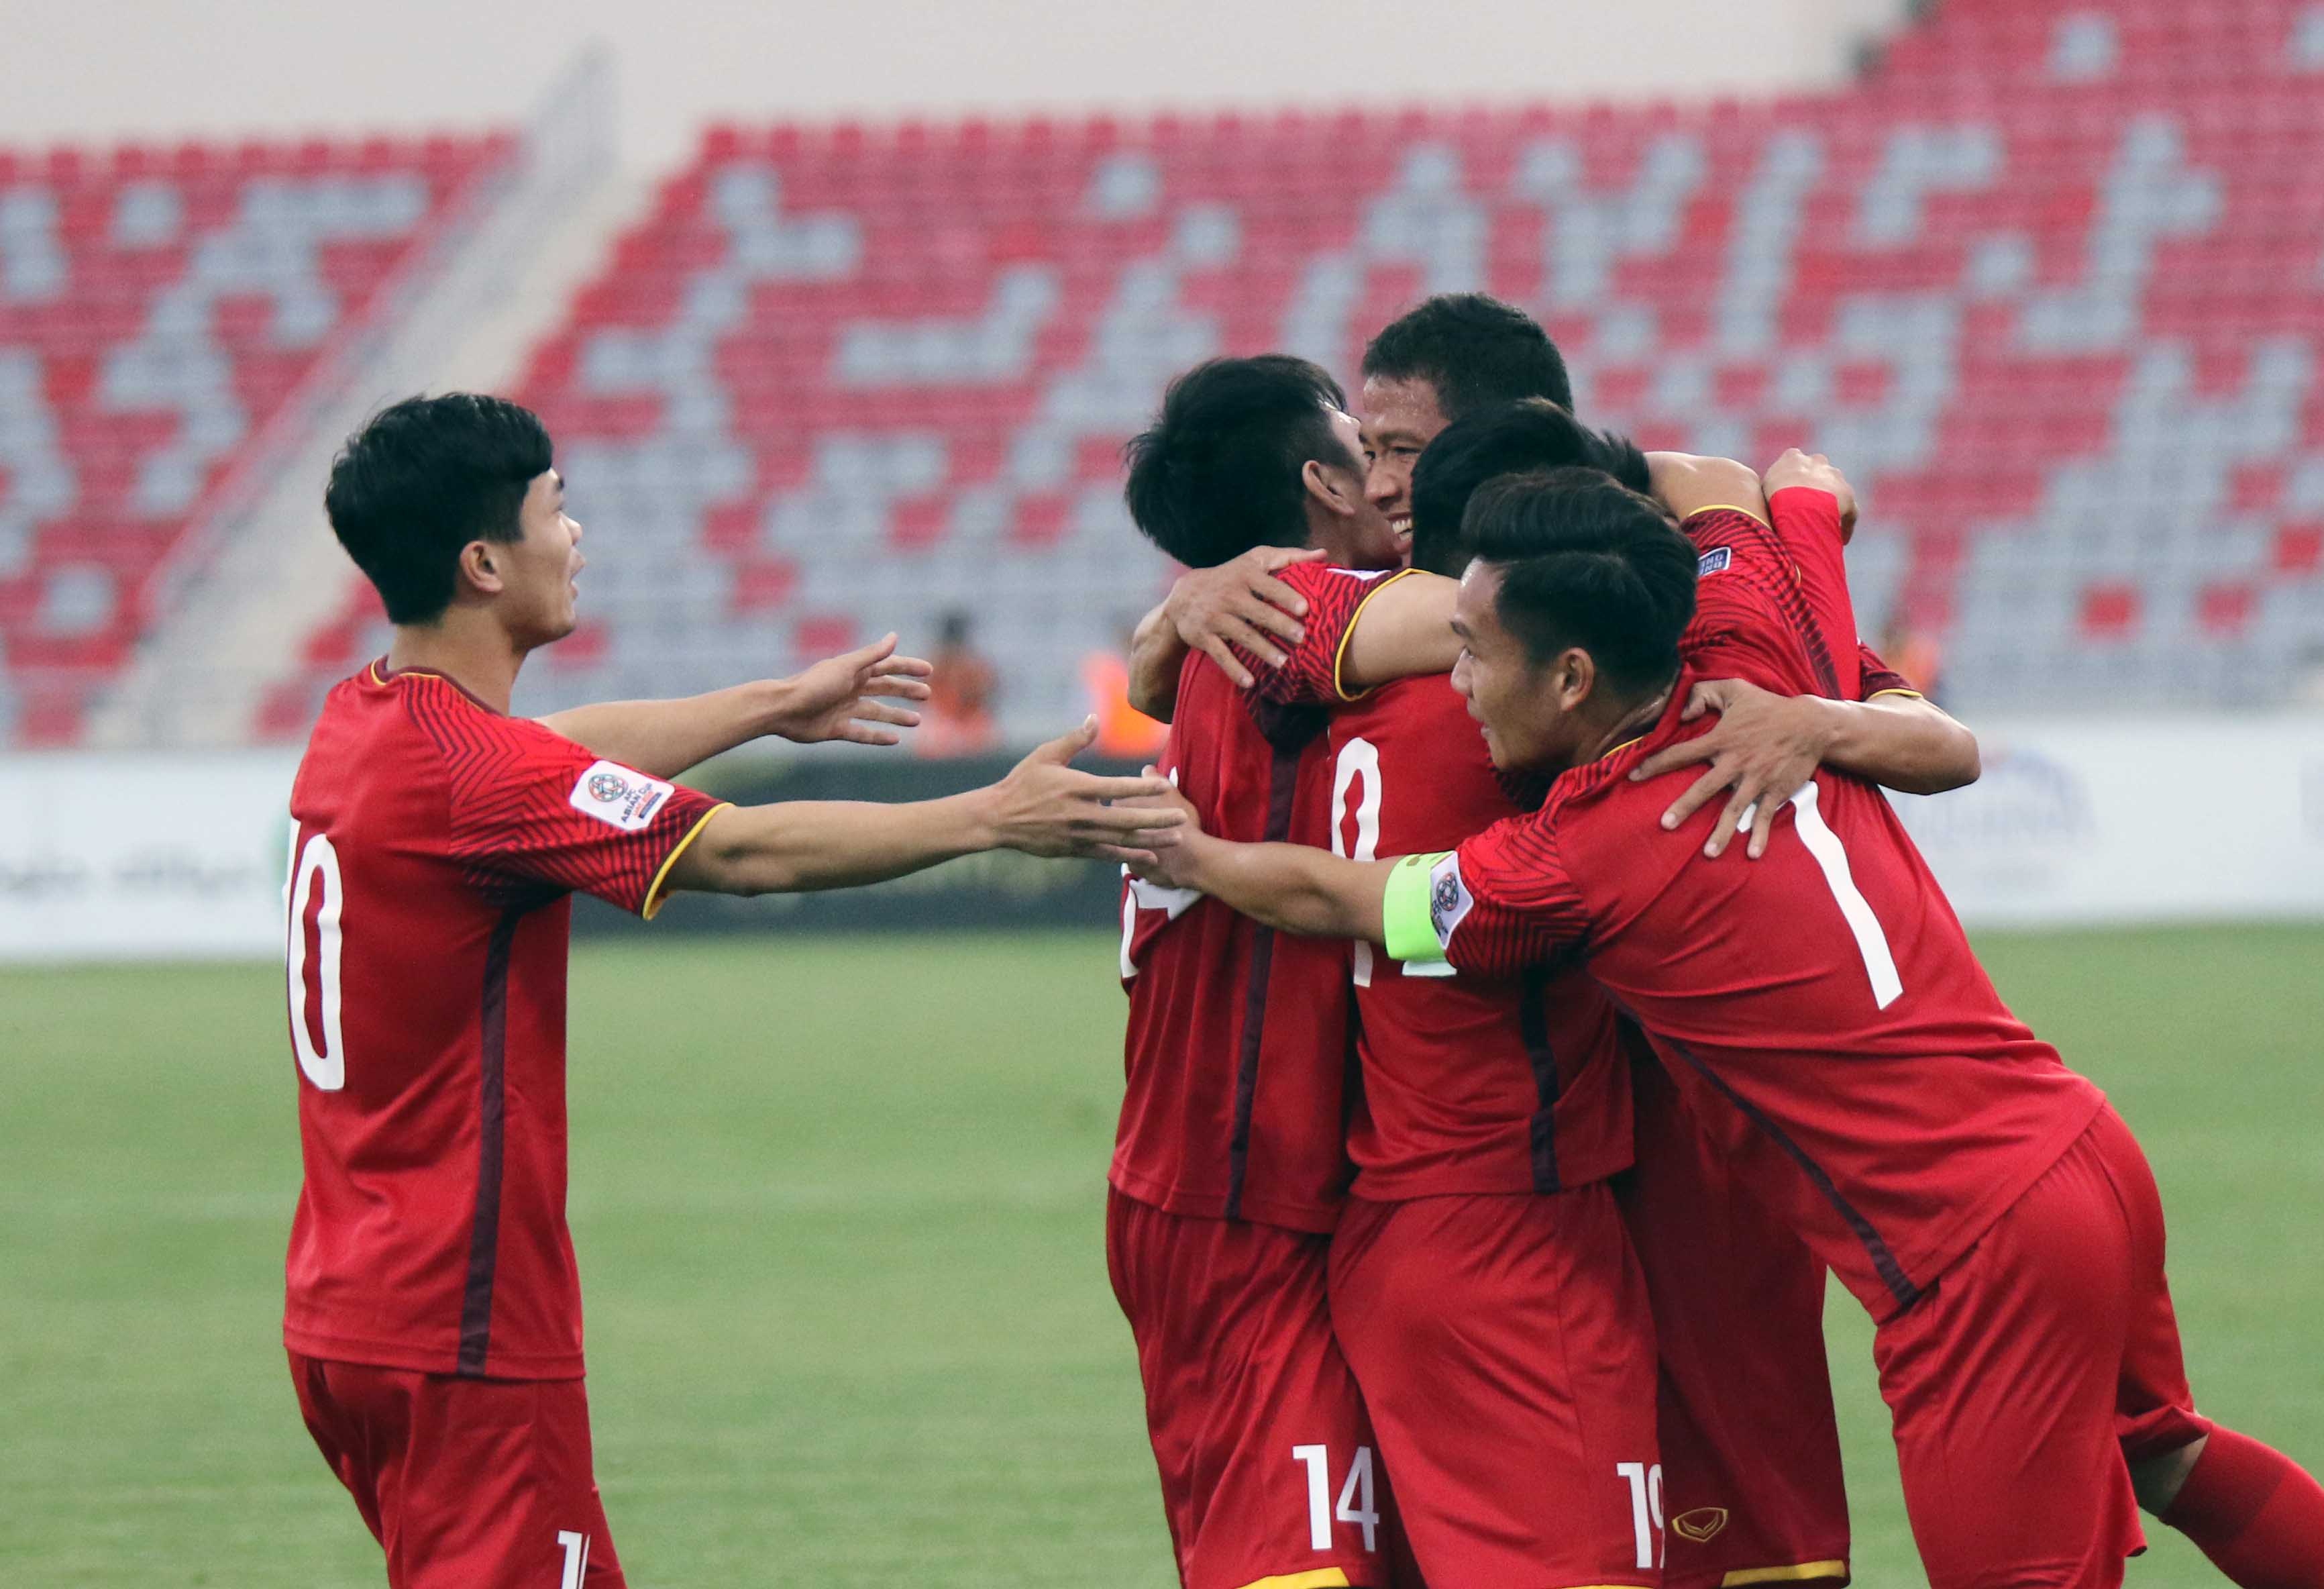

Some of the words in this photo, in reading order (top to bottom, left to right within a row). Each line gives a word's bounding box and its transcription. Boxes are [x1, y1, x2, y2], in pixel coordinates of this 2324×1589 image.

[282, 818, 345, 1090] 0
[1292, 1444, 1379, 1552] 14
[558, 1529, 590, 1589] 1
